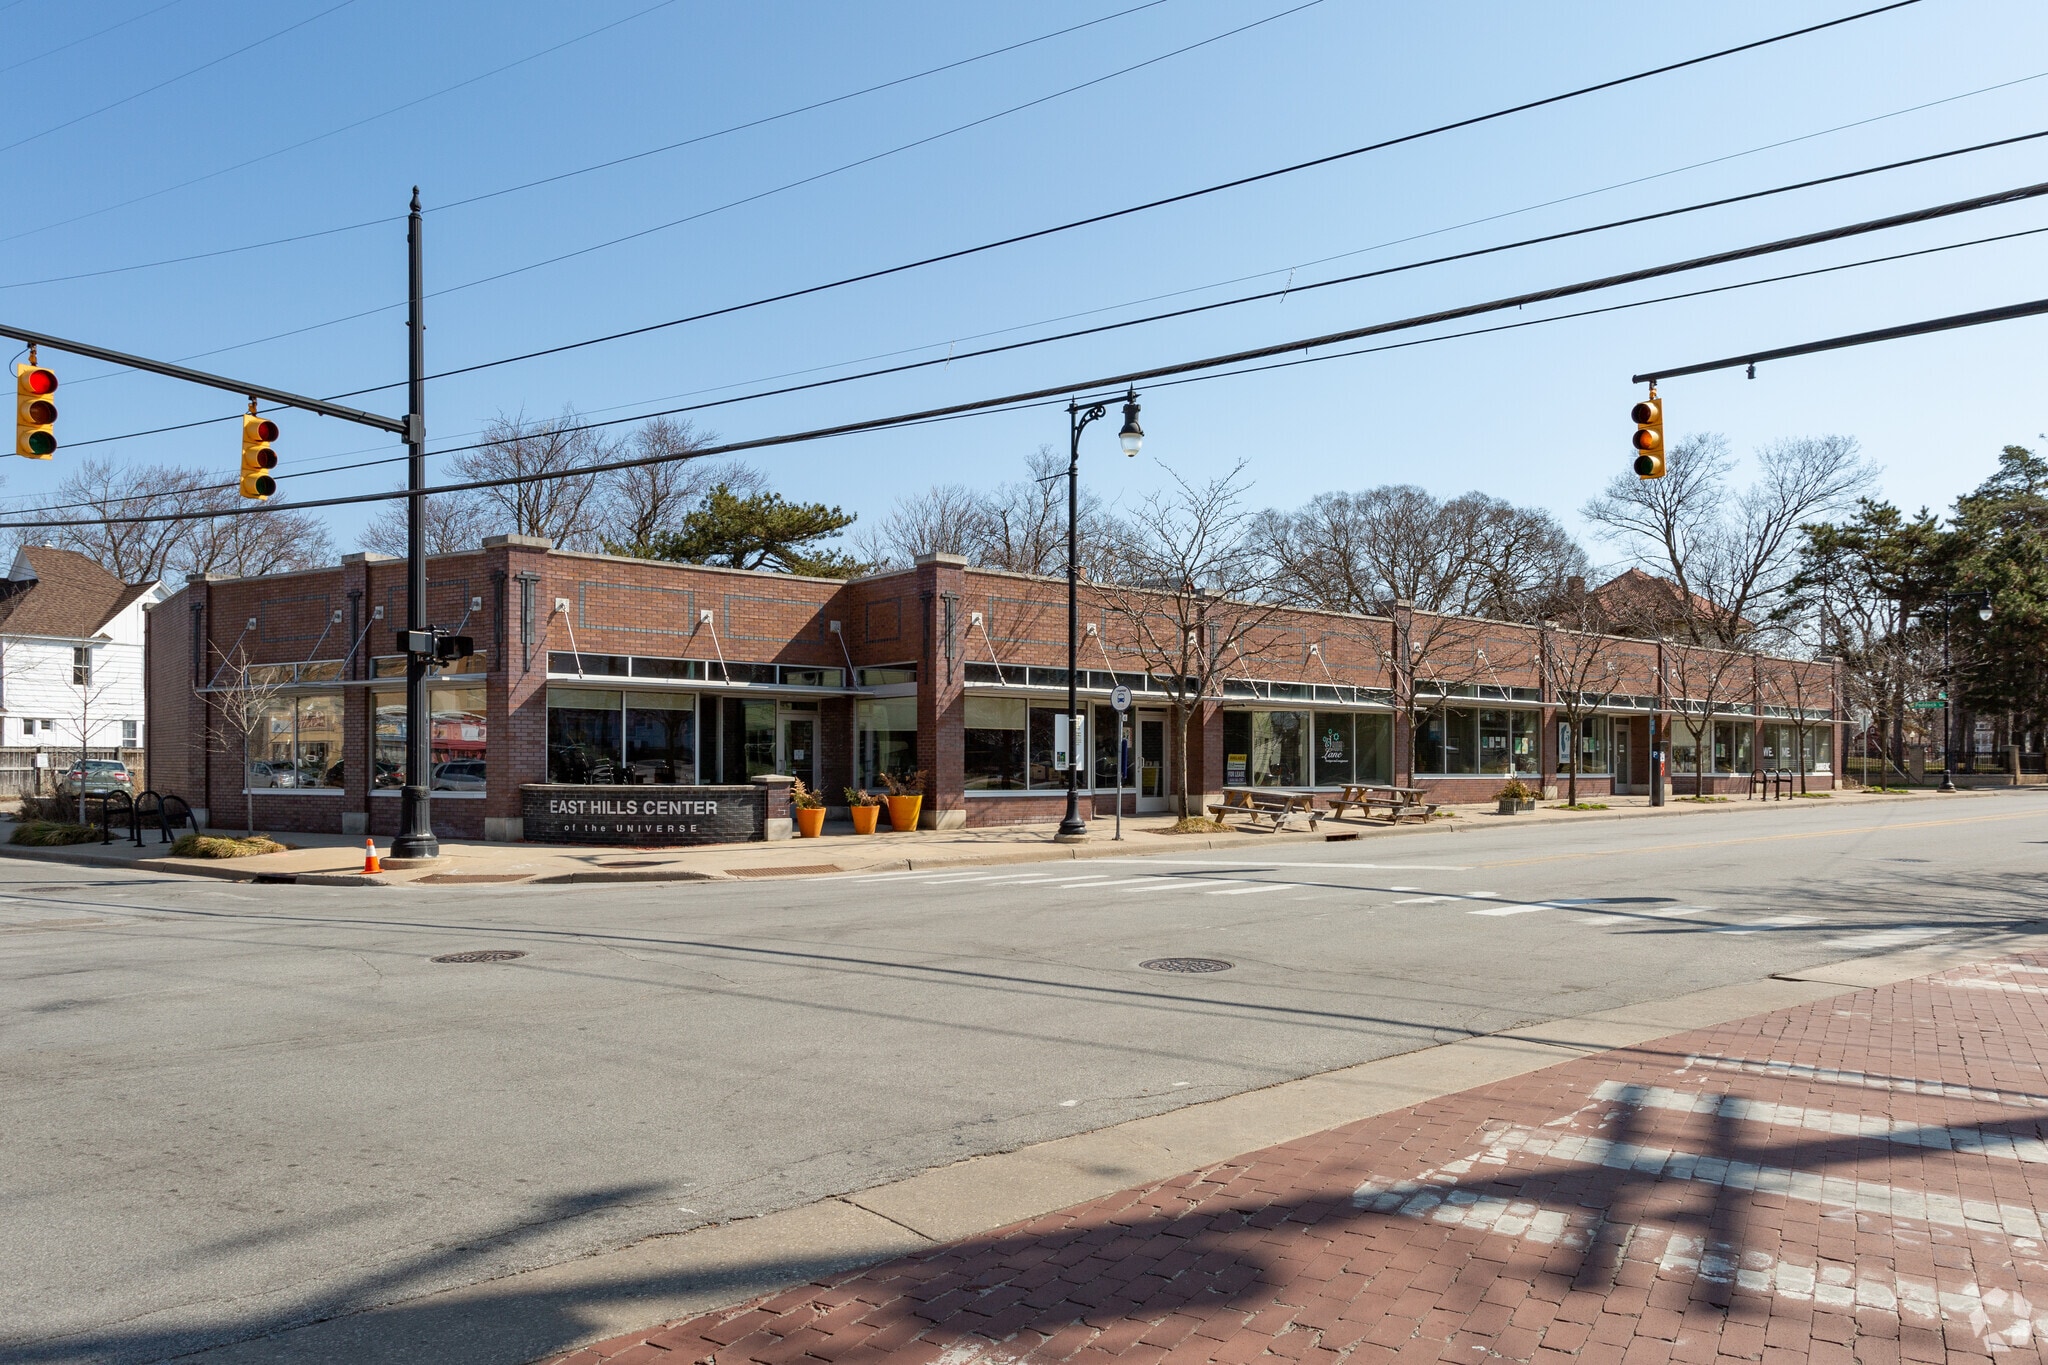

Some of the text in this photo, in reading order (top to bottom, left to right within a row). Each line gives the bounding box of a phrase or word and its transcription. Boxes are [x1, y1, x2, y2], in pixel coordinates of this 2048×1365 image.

[550, 800, 718, 815] EAST HILLS CENTER
[564, 824, 697, 833] of the UNIVERSE
